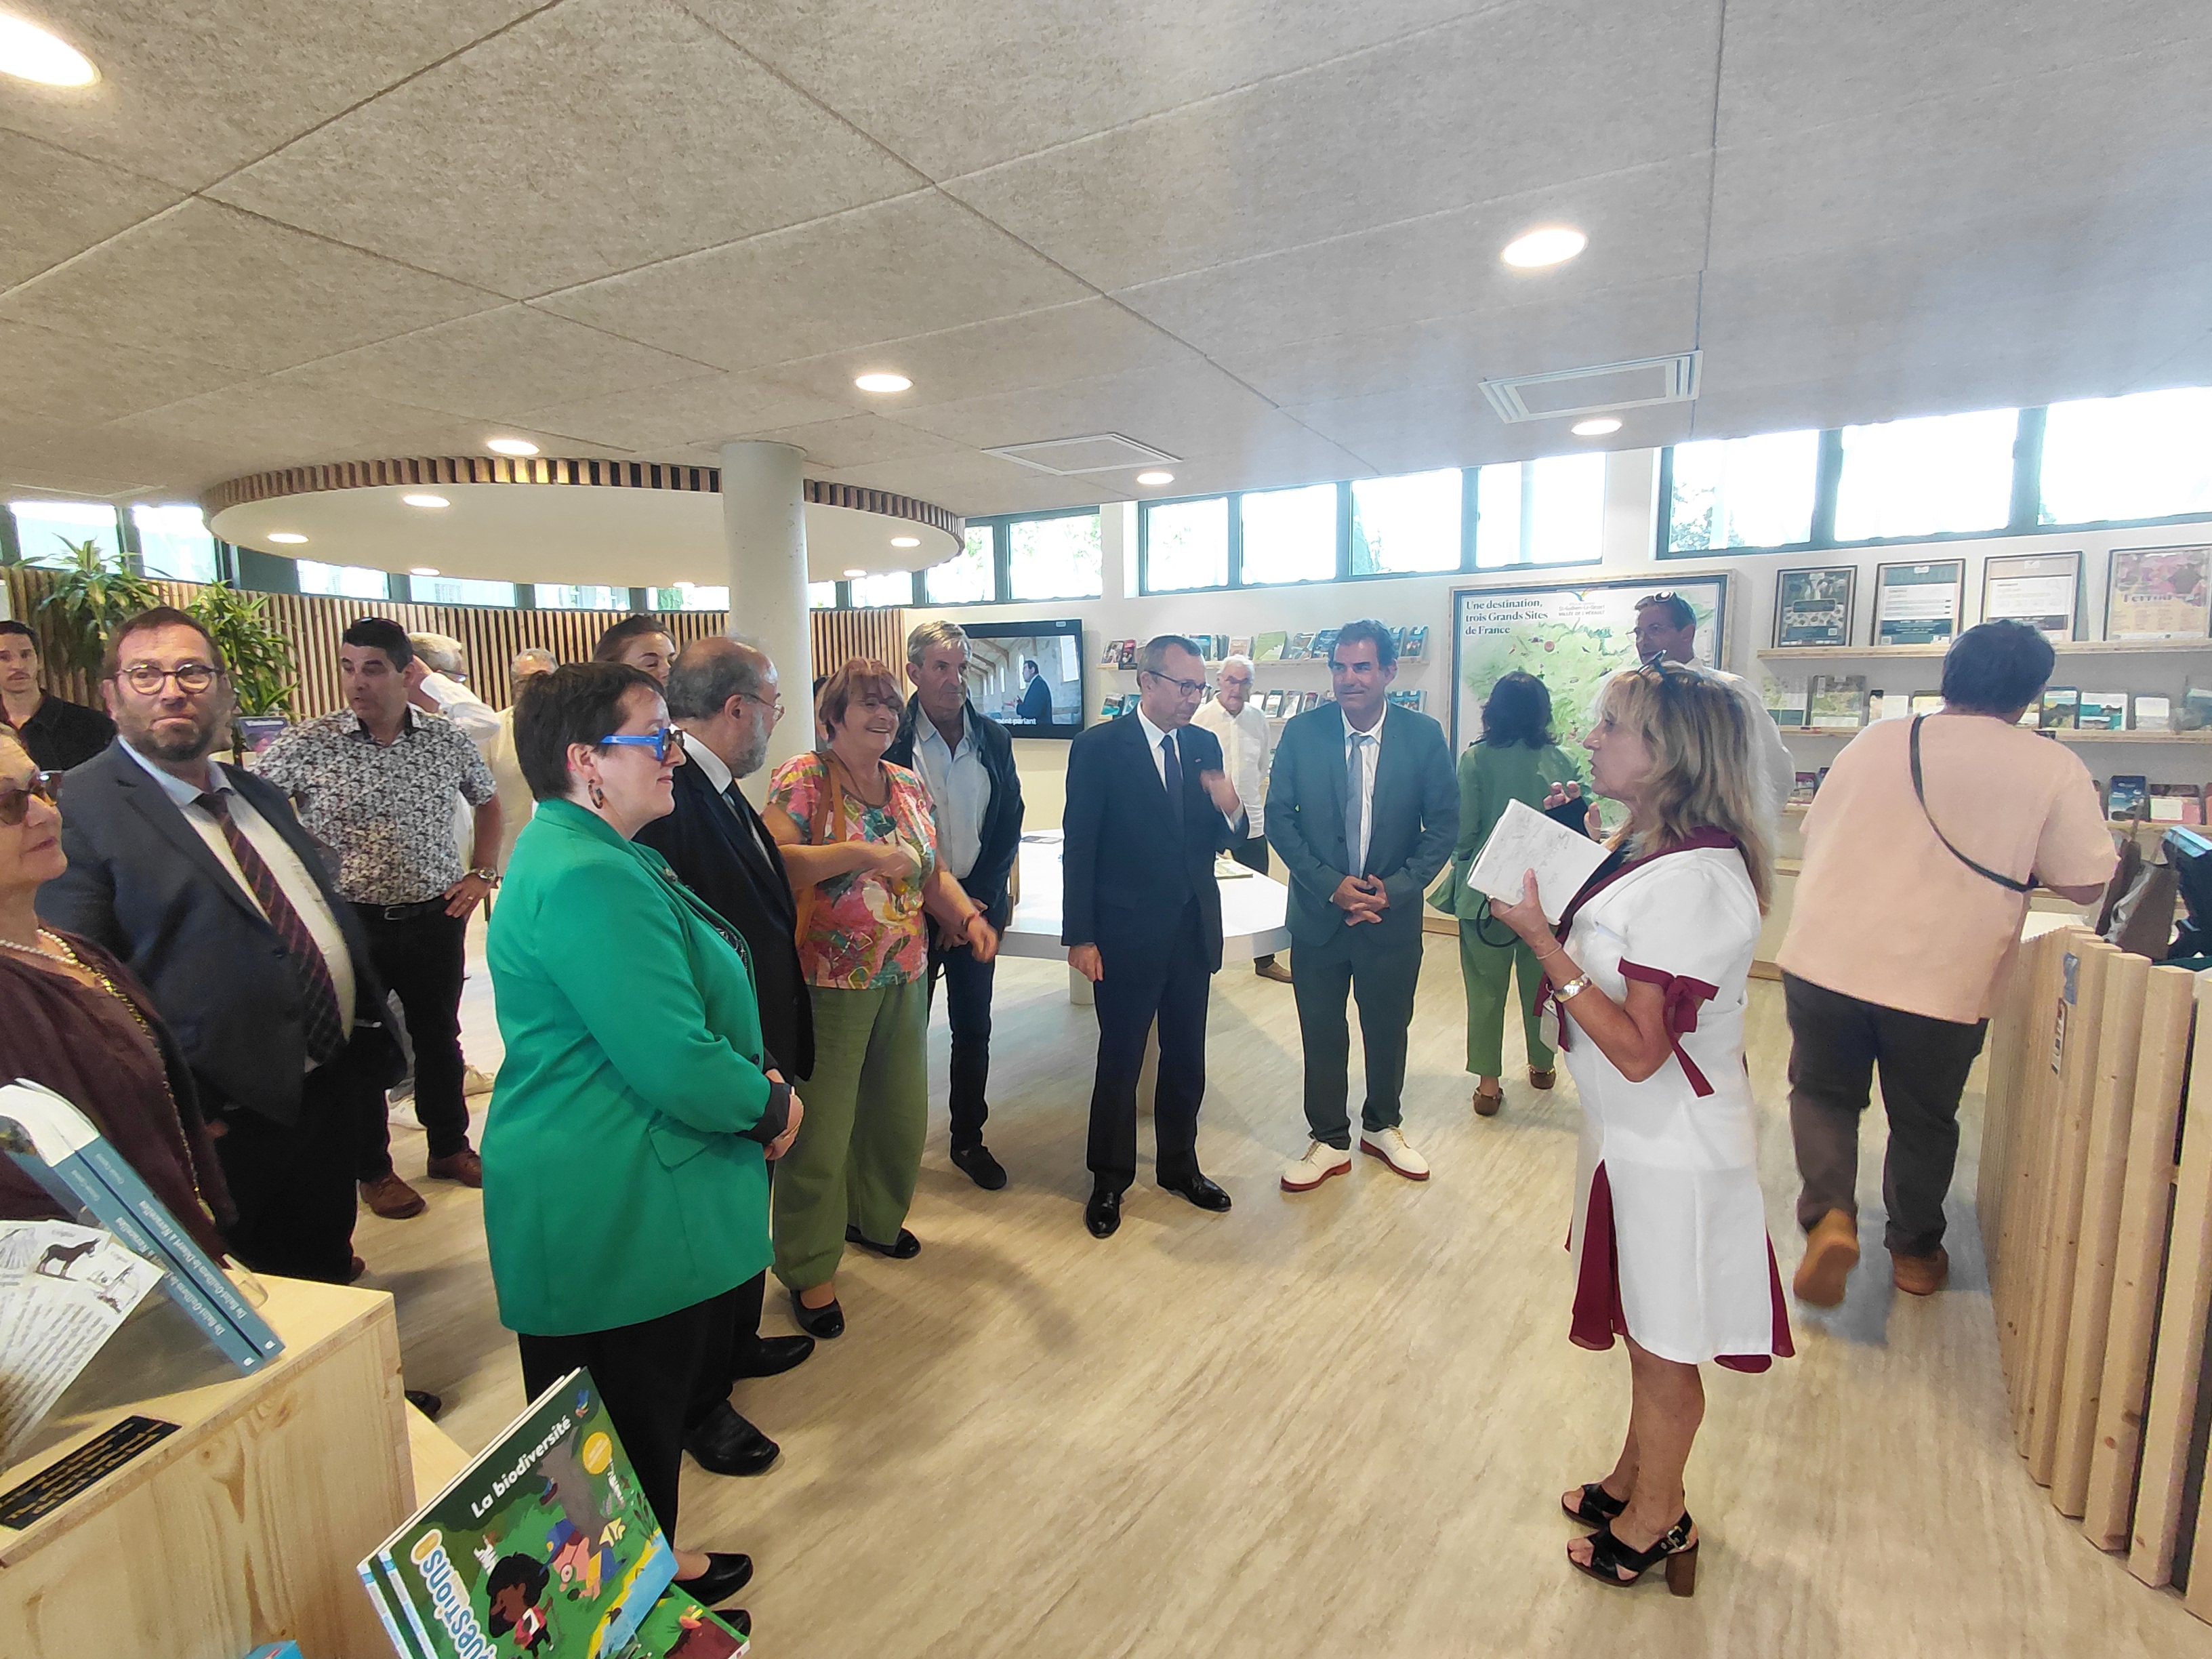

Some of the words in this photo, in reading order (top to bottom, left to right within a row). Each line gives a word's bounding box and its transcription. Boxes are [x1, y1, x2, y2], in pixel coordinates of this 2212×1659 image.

[1466, 600, 1485, 610] Une
[1486, 598, 1543, 609] destination,
[1465, 613, 1487, 622] trois
[1488, 611, 1523, 621] Grands
[1524, 611, 1549, 620] Sites
[1465, 626, 1477, 635] de
[1478, 625, 1511, 634] France
[138, 1200, 173, 1237] Navacelles
[115, 1216, 149, 1253] Navacelles
[235, 1308, 247, 1319] De
[214, 1324, 226, 1336] De
[471, 1494, 493, 1519] La
[492, 1414, 571, 1498] biodiversité
